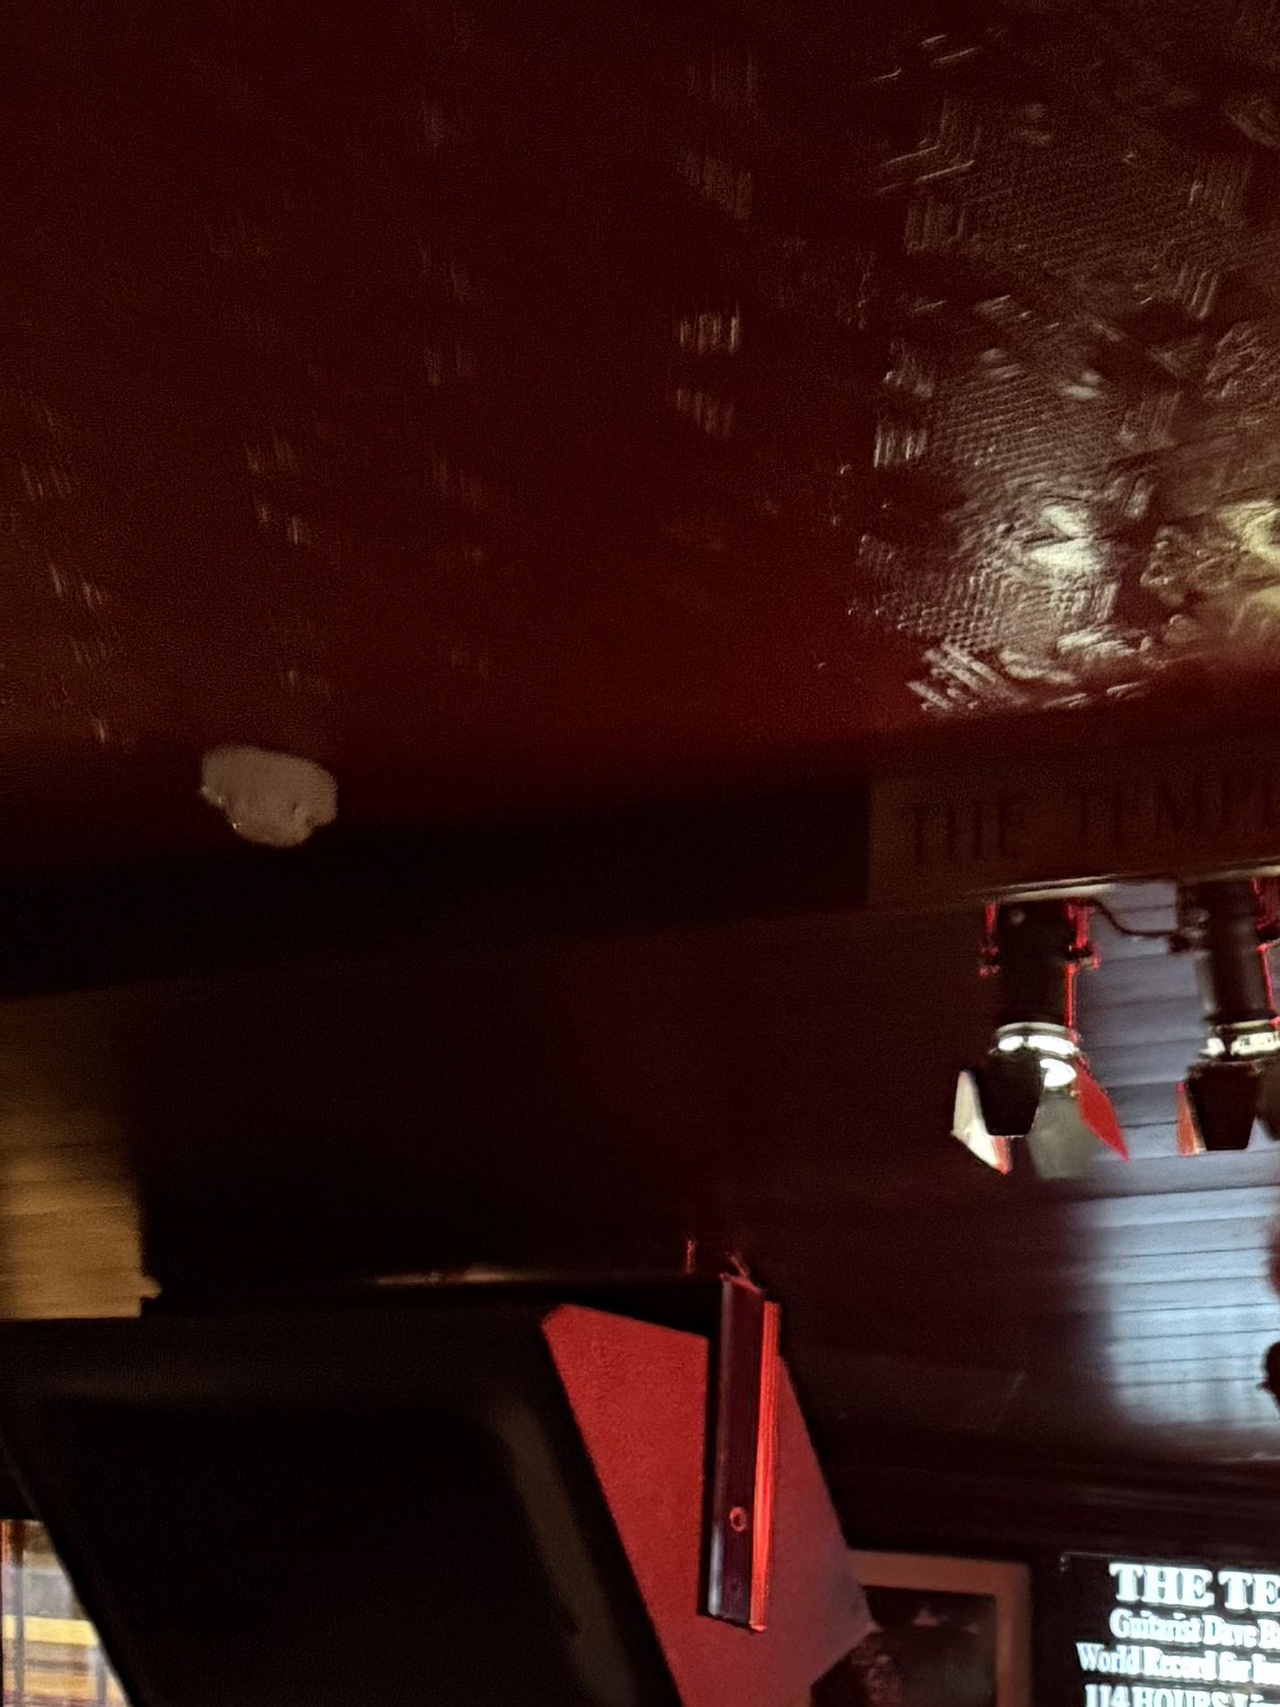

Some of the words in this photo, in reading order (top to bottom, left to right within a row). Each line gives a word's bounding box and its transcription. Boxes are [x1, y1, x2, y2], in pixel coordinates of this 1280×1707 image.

[1109, 1562, 1215, 1608] THE
[1109, 1608, 1201, 1643] Guitarist
[1202, 1615, 1259, 1648] Dave
[1076, 1642, 1141, 1675] World
[1141, 1646, 1218, 1681] Record
